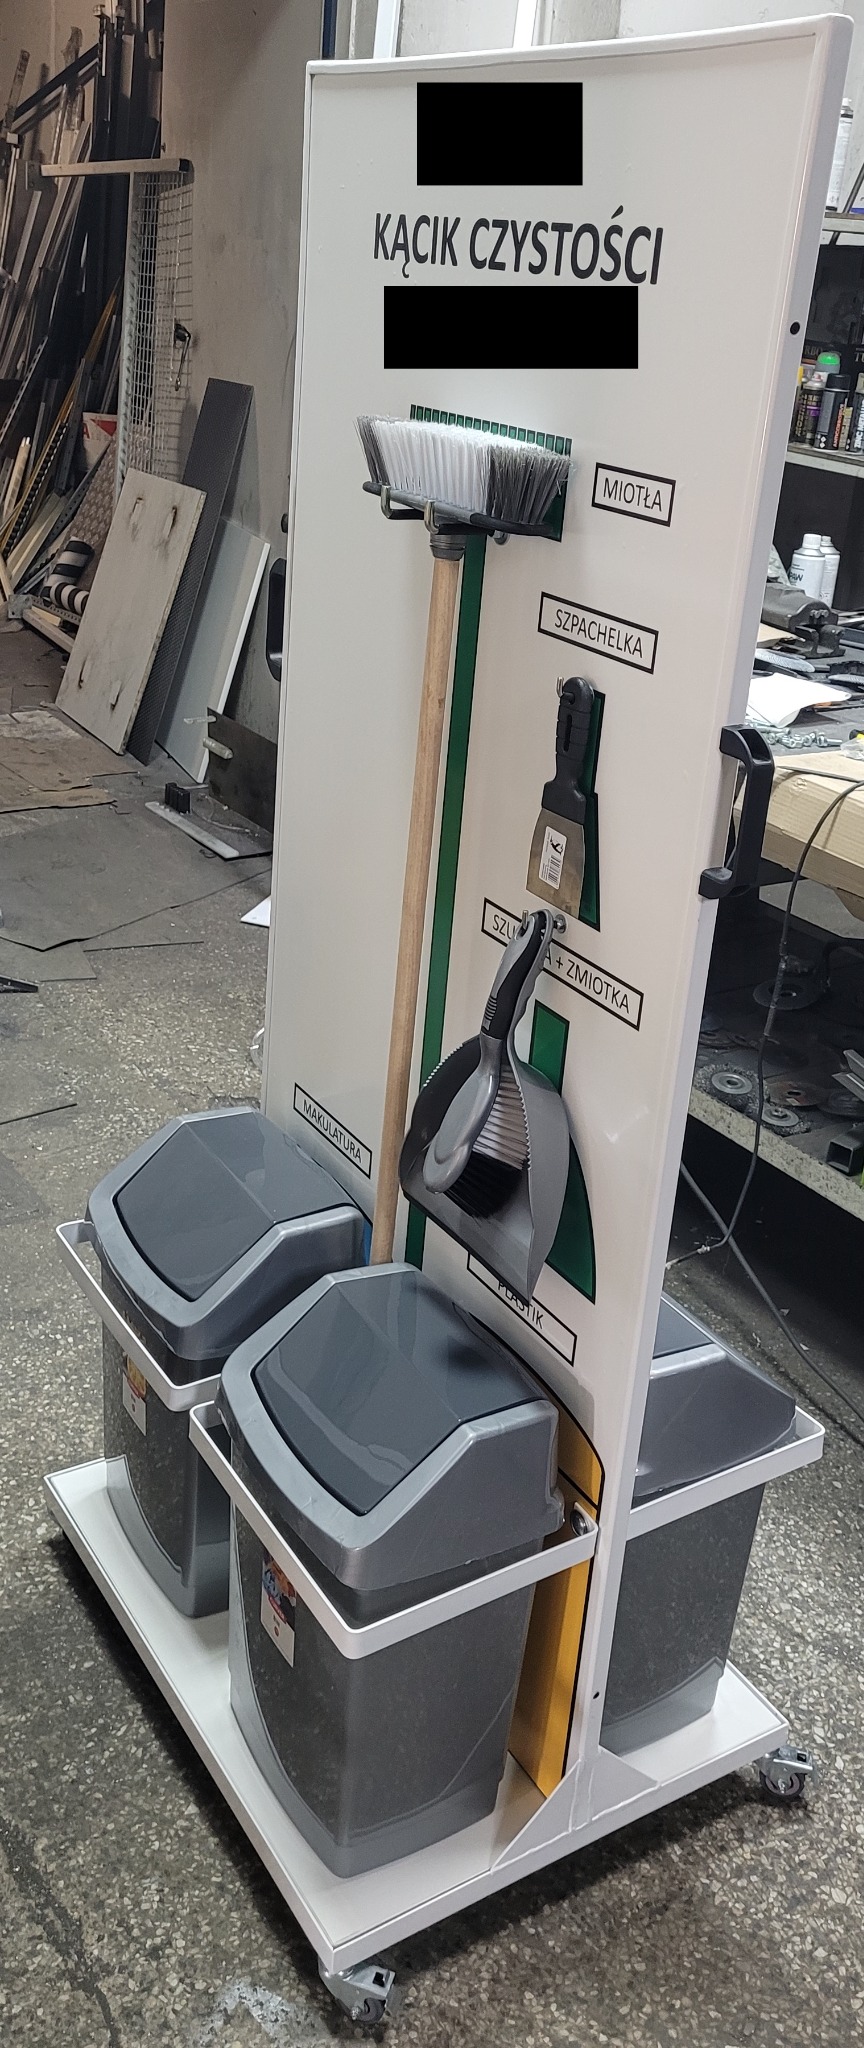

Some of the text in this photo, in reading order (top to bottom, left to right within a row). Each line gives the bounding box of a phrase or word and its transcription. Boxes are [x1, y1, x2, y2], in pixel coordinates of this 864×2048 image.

[373, 204, 664, 285] KĄCIK CZYSTOŚCI
[602, 477, 663, 513] MIOTŁA
[554, 608, 643, 659] SZPACHELKA
[492, 913, 630, 1014] SZUA + ZMIOTKA
[303, 1098, 362, 1164] MAKULATURA
